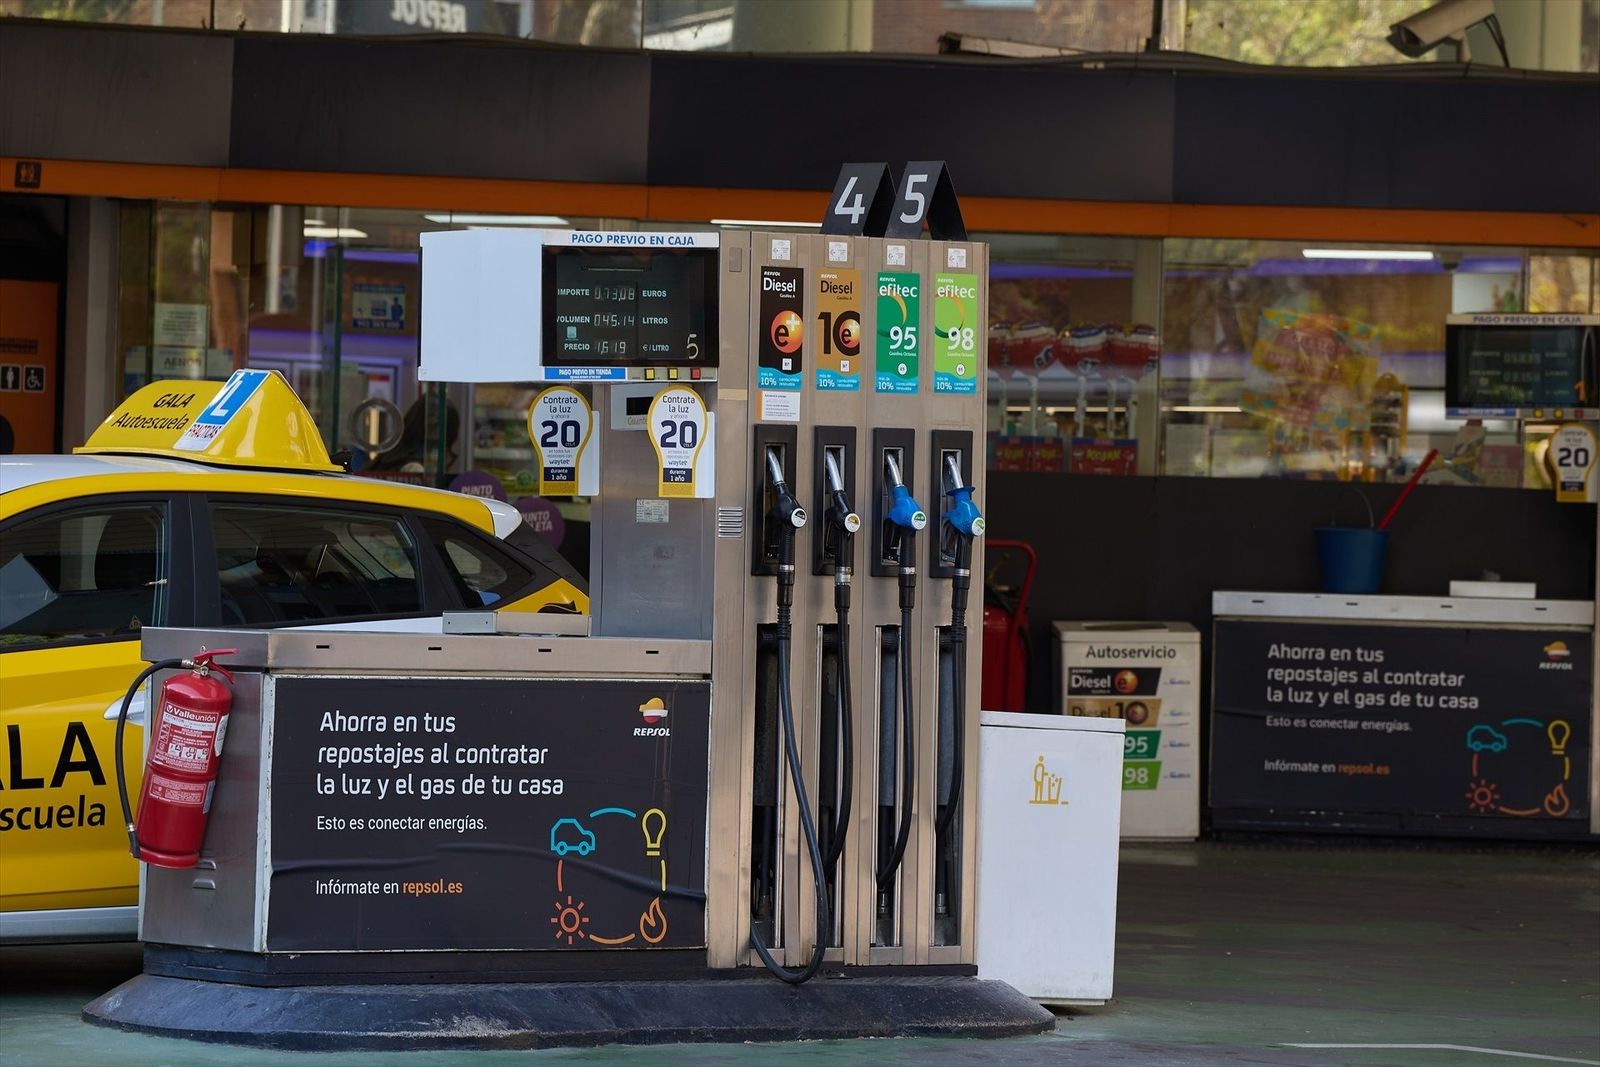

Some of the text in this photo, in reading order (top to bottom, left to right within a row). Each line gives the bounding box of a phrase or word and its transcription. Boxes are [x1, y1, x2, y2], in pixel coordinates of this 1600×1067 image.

[833, 176, 866, 224] 4
[899, 173, 929, 223] 5
[571, 233, 695, 245] PAGO PREVIO EN CAJA
[557, 288, 590, 297] IMPORTE
[642, 289, 667, 297] EUROS
[763, 277, 796, 292] Diesel
[820, 280, 853, 294] Diesel
[879, 283, 918, 298] efitec
[937, 284, 975, 299] efitec
[642, 317, 668, 325] LITROS
[1473, 315, 1582, 323] PAGO PREVIO EN CAJA
[686, 333, 699, 360] 5
[889, 326, 917, 351] 95
[947, 327, 974, 351] 98
[564, 343, 590, 351] PRECIO
[760, 377, 777, 386] 10%
[819, 379, 835, 387] 10%
[878, 382, 895, 390] 10%
[936, 382, 953, 390] 10%
[153, 393, 197, 409] GALA
[543, 396, 578, 404] Contrata
[662, 395, 695, 404] Contrata
[549, 404, 571, 413] la luz
[668, 405, 689, 413] la luz
[113, 411, 190, 431] Autoescuela
[541, 420, 581, 448] 20
[660, 420, 697, 449] 20
[1558, 447, 1589, 468] 20
[461, 485, 493, 496] PUNTO
[1085, 645, 1176, 659] Autoservicio
[1267, 644, 1384, 663] Ahorra en tus
[1071, 674, 1111, 688] Diesel
[1266, 666, 1464, 688] repostajes al contratar
[1266, 686, 1480, 709] la luz y el gas de tu casa
[173, 707, 217, 722] Valleunión
[319, 710, 456, 733] Ahorra en tus
[1265, 714, 1414, 733] Esto es conectar energías.
[633, 727, 671, 737] REPSOL
[1124, 736, 1149, 753] 95
[0, 722, 107, 791] LA
[318, 742, 548, 769] repostajes al contratar
[1124, 767, 1149, 784] 98
[1264, 760, 1391, 776] Infórmate en repsol.es
[316, 773, 564, 800] la luz y el gas de tu casa
[316, 815, 488, 833] Esto es conectar energías.
[315, 879, 463, 897] Infórmate en repsol.es
